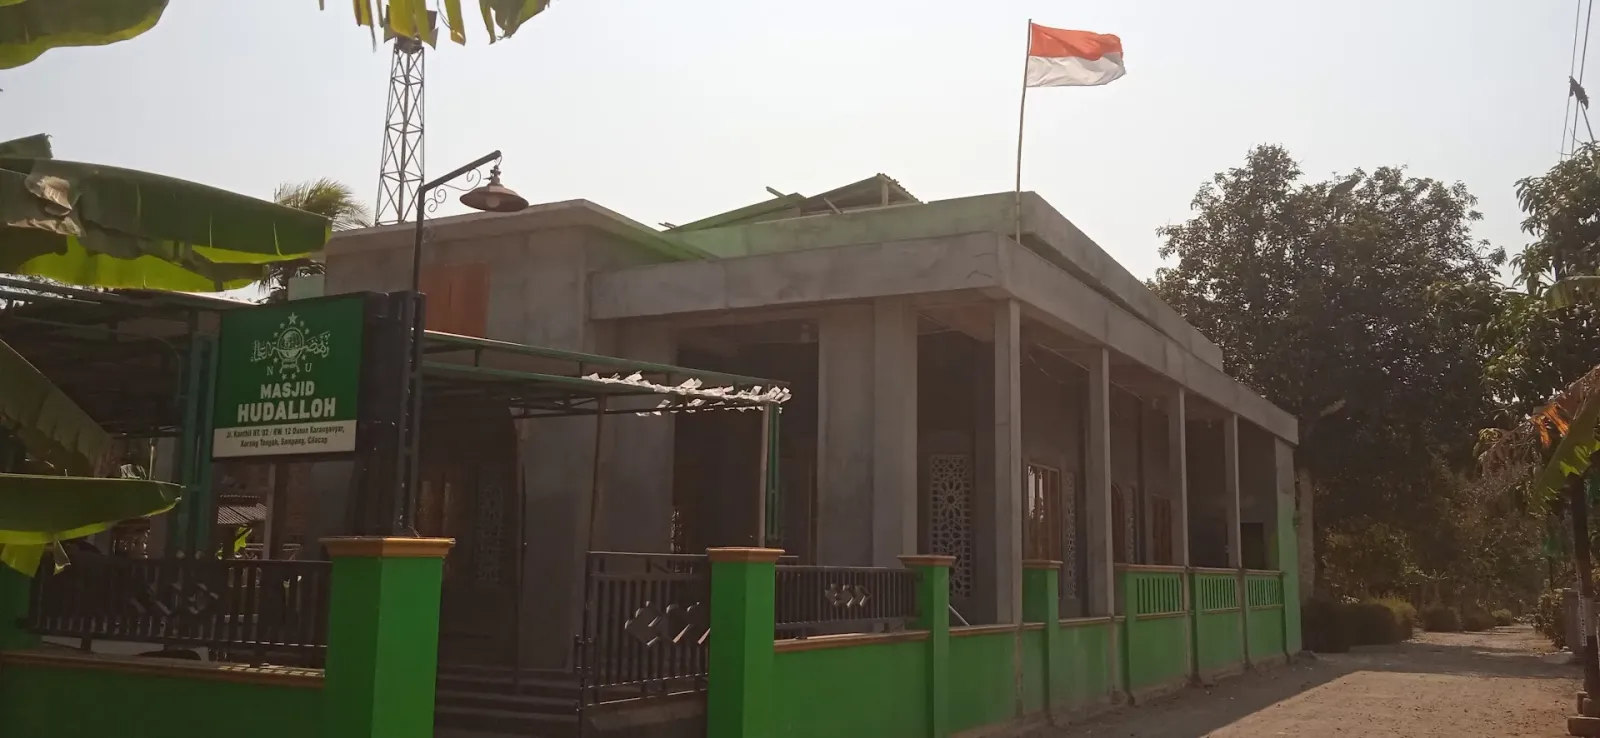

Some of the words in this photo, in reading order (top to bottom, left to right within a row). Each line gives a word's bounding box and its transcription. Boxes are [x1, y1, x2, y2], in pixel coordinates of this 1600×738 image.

[266, 365, 274, 376] N
[305, 362, 312, 373] U
[260, 381, 315, 399] MASJID
[237, 397, 336, 423] HUDALLOH
[284, 427, 291, 435] 12
[240, 440, 259, 448] Karang
